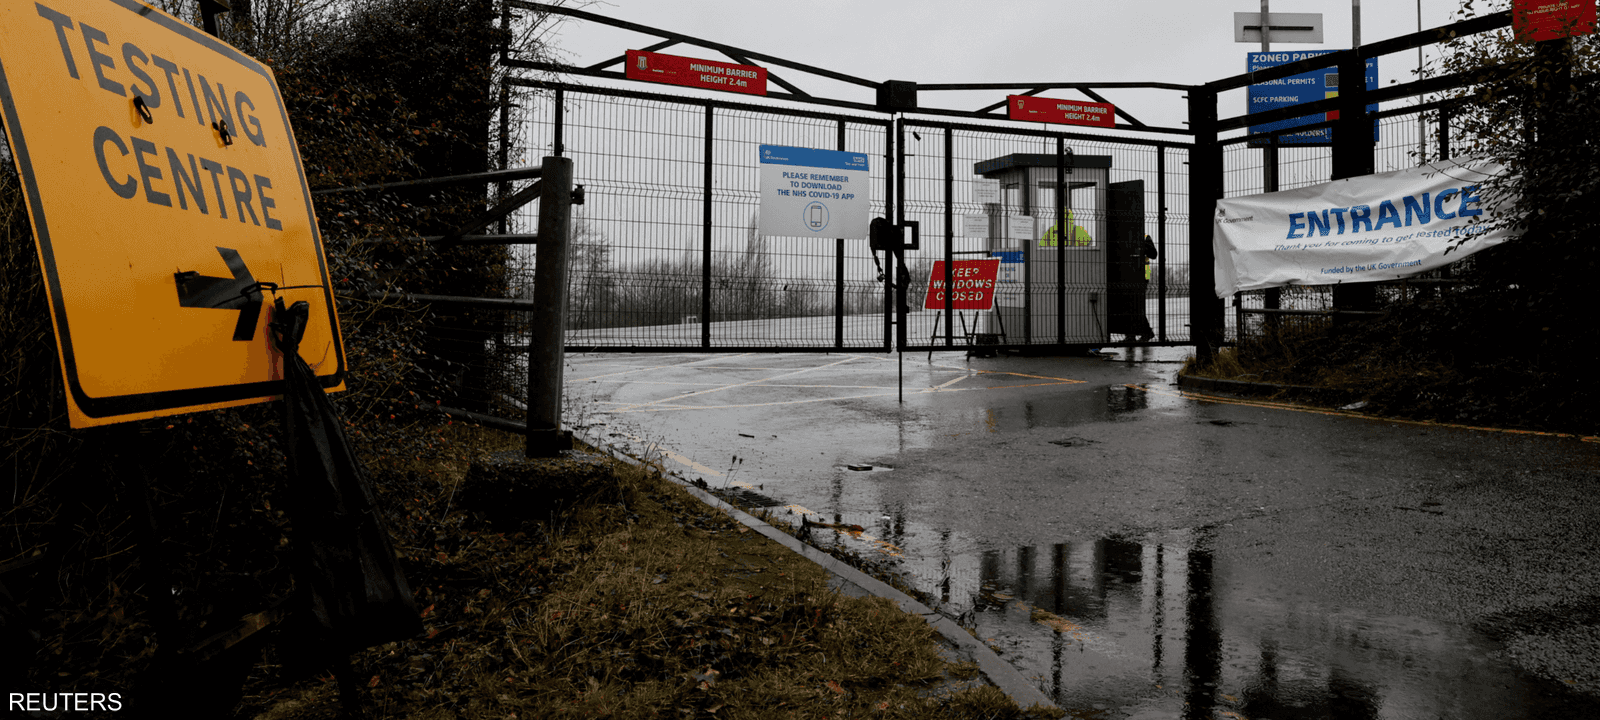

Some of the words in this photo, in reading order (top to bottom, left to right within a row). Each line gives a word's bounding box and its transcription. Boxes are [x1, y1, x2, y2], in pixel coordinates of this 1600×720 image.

[1252, 54, 1290, 63] ZONED
[35, 2, 267, 148] TESTING
[690, 63, 725, 74] MINIMUM
[726, 68, 758, 79] BARRIER
[700, 74, 728, 85] HEIGHT
[729, 78, 748, 87] 2.4m
[1056, 104, 1083, 112] MINIMUM
[1084, 106, 1108, 114] BARRIER
[93, 125, 283, 231] CENTRE
[782, 171, 808, 180] PLEASE
[810, 173, 849, 183] REMEMBER
[801, 182, 842, 191] DOWNLOAD
[808, 191, 840, 199] COVID-19
[1286, 185, 1483, 239] ENTRANCE
[1223, 215, 1254, 224] Government
[1274, 243, 1301, 252] Thank
[1302, 242, 1322, 251] you
[1341, 237, 1379, 246] coming
[1382, 234, 1394, 243] to
[1395, 233, 1414, 243] get
[1416, 227, 1452, 239] tested
[1321, 265, 1345, 275] Funded
[1346, 265, 1354, 274] by
[1355, 264, 1366, 272] the
[1378, 259, 1422, 270] Government
[935, 290, 984, 301] COSED
